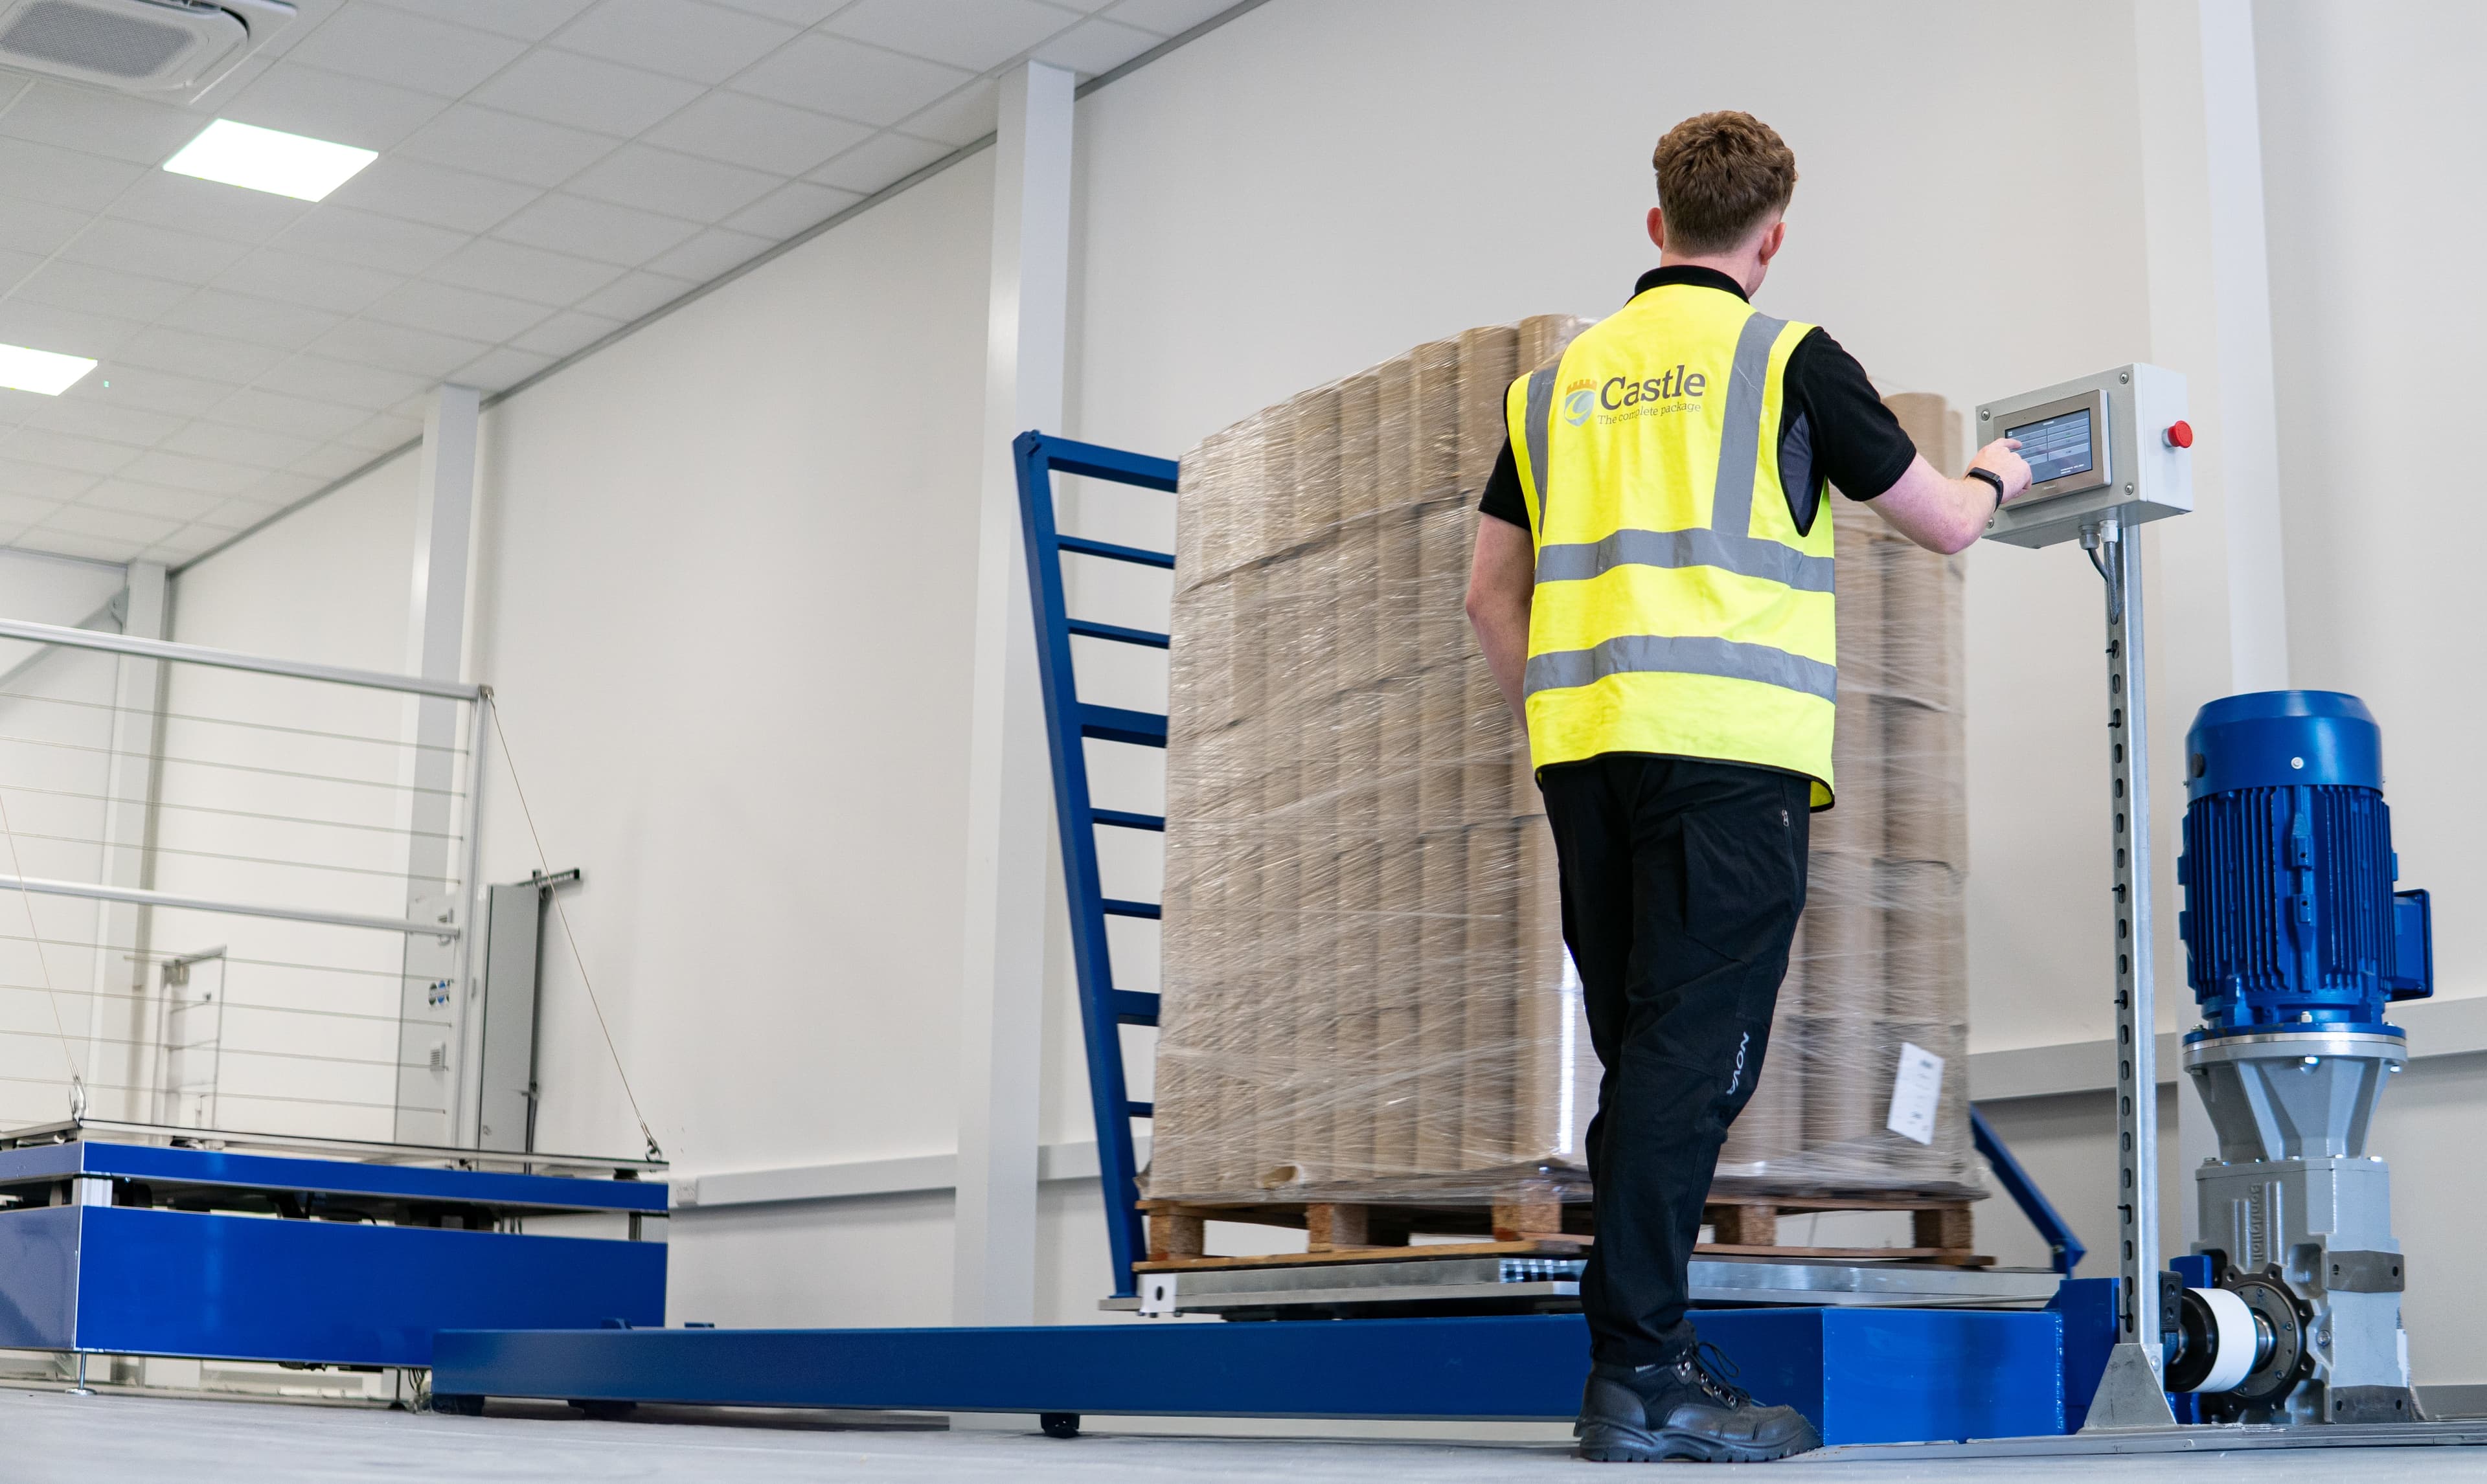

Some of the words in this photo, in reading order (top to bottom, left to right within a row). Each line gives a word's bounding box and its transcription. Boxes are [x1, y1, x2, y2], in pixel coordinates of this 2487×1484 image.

[1600, 365, 1706, 410] Castle
[1598, 414, 1617, 425] The
[1618, 406, 1658, 422] complete
[1661, 401, 1701, 416] package
[1726, 1031, 1749, 1095] NOVA
